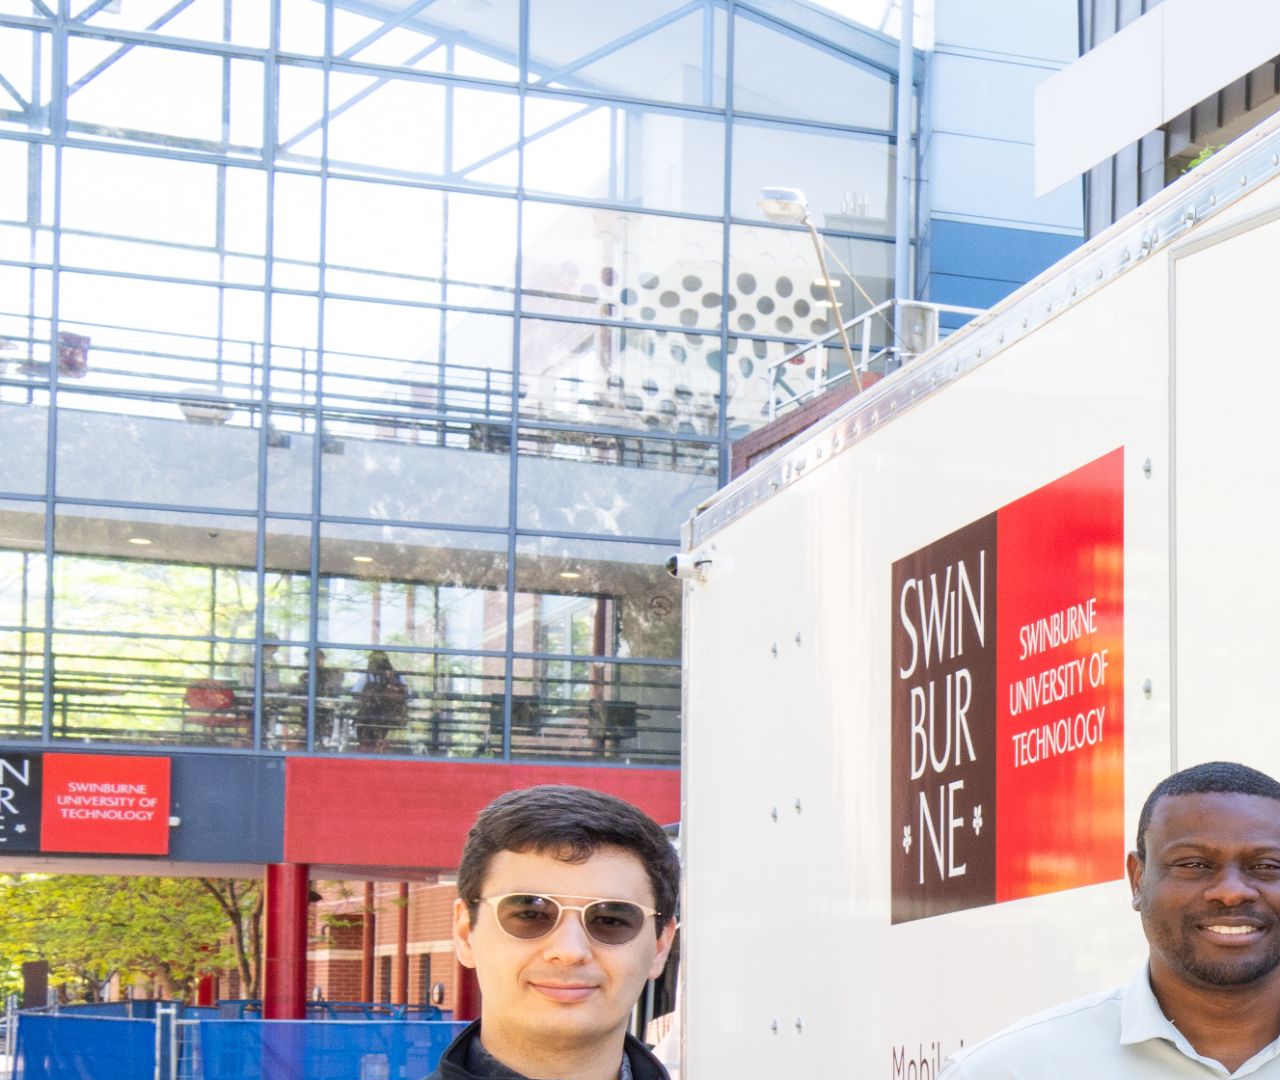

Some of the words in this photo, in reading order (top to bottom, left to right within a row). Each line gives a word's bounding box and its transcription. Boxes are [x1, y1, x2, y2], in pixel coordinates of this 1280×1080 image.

[1019, 597, 1098, 661] SWINBURNE
[1009, 657, 1086, 717] UNIVERSITY
[1089, 649, 1109, 688] OF
[910, 667, 977, 781] BUR
[1012, 706, 1106, 768] TECHNOLOGY
[57, 796, 135, 807] UNIVERSITY
[139, 797, 157, 808] OF
[60, 808, 155, 821] TECHNOLOGY
[68, 782, 147, 795] SWINBURNE
[918, 779, 967, 885] NE
